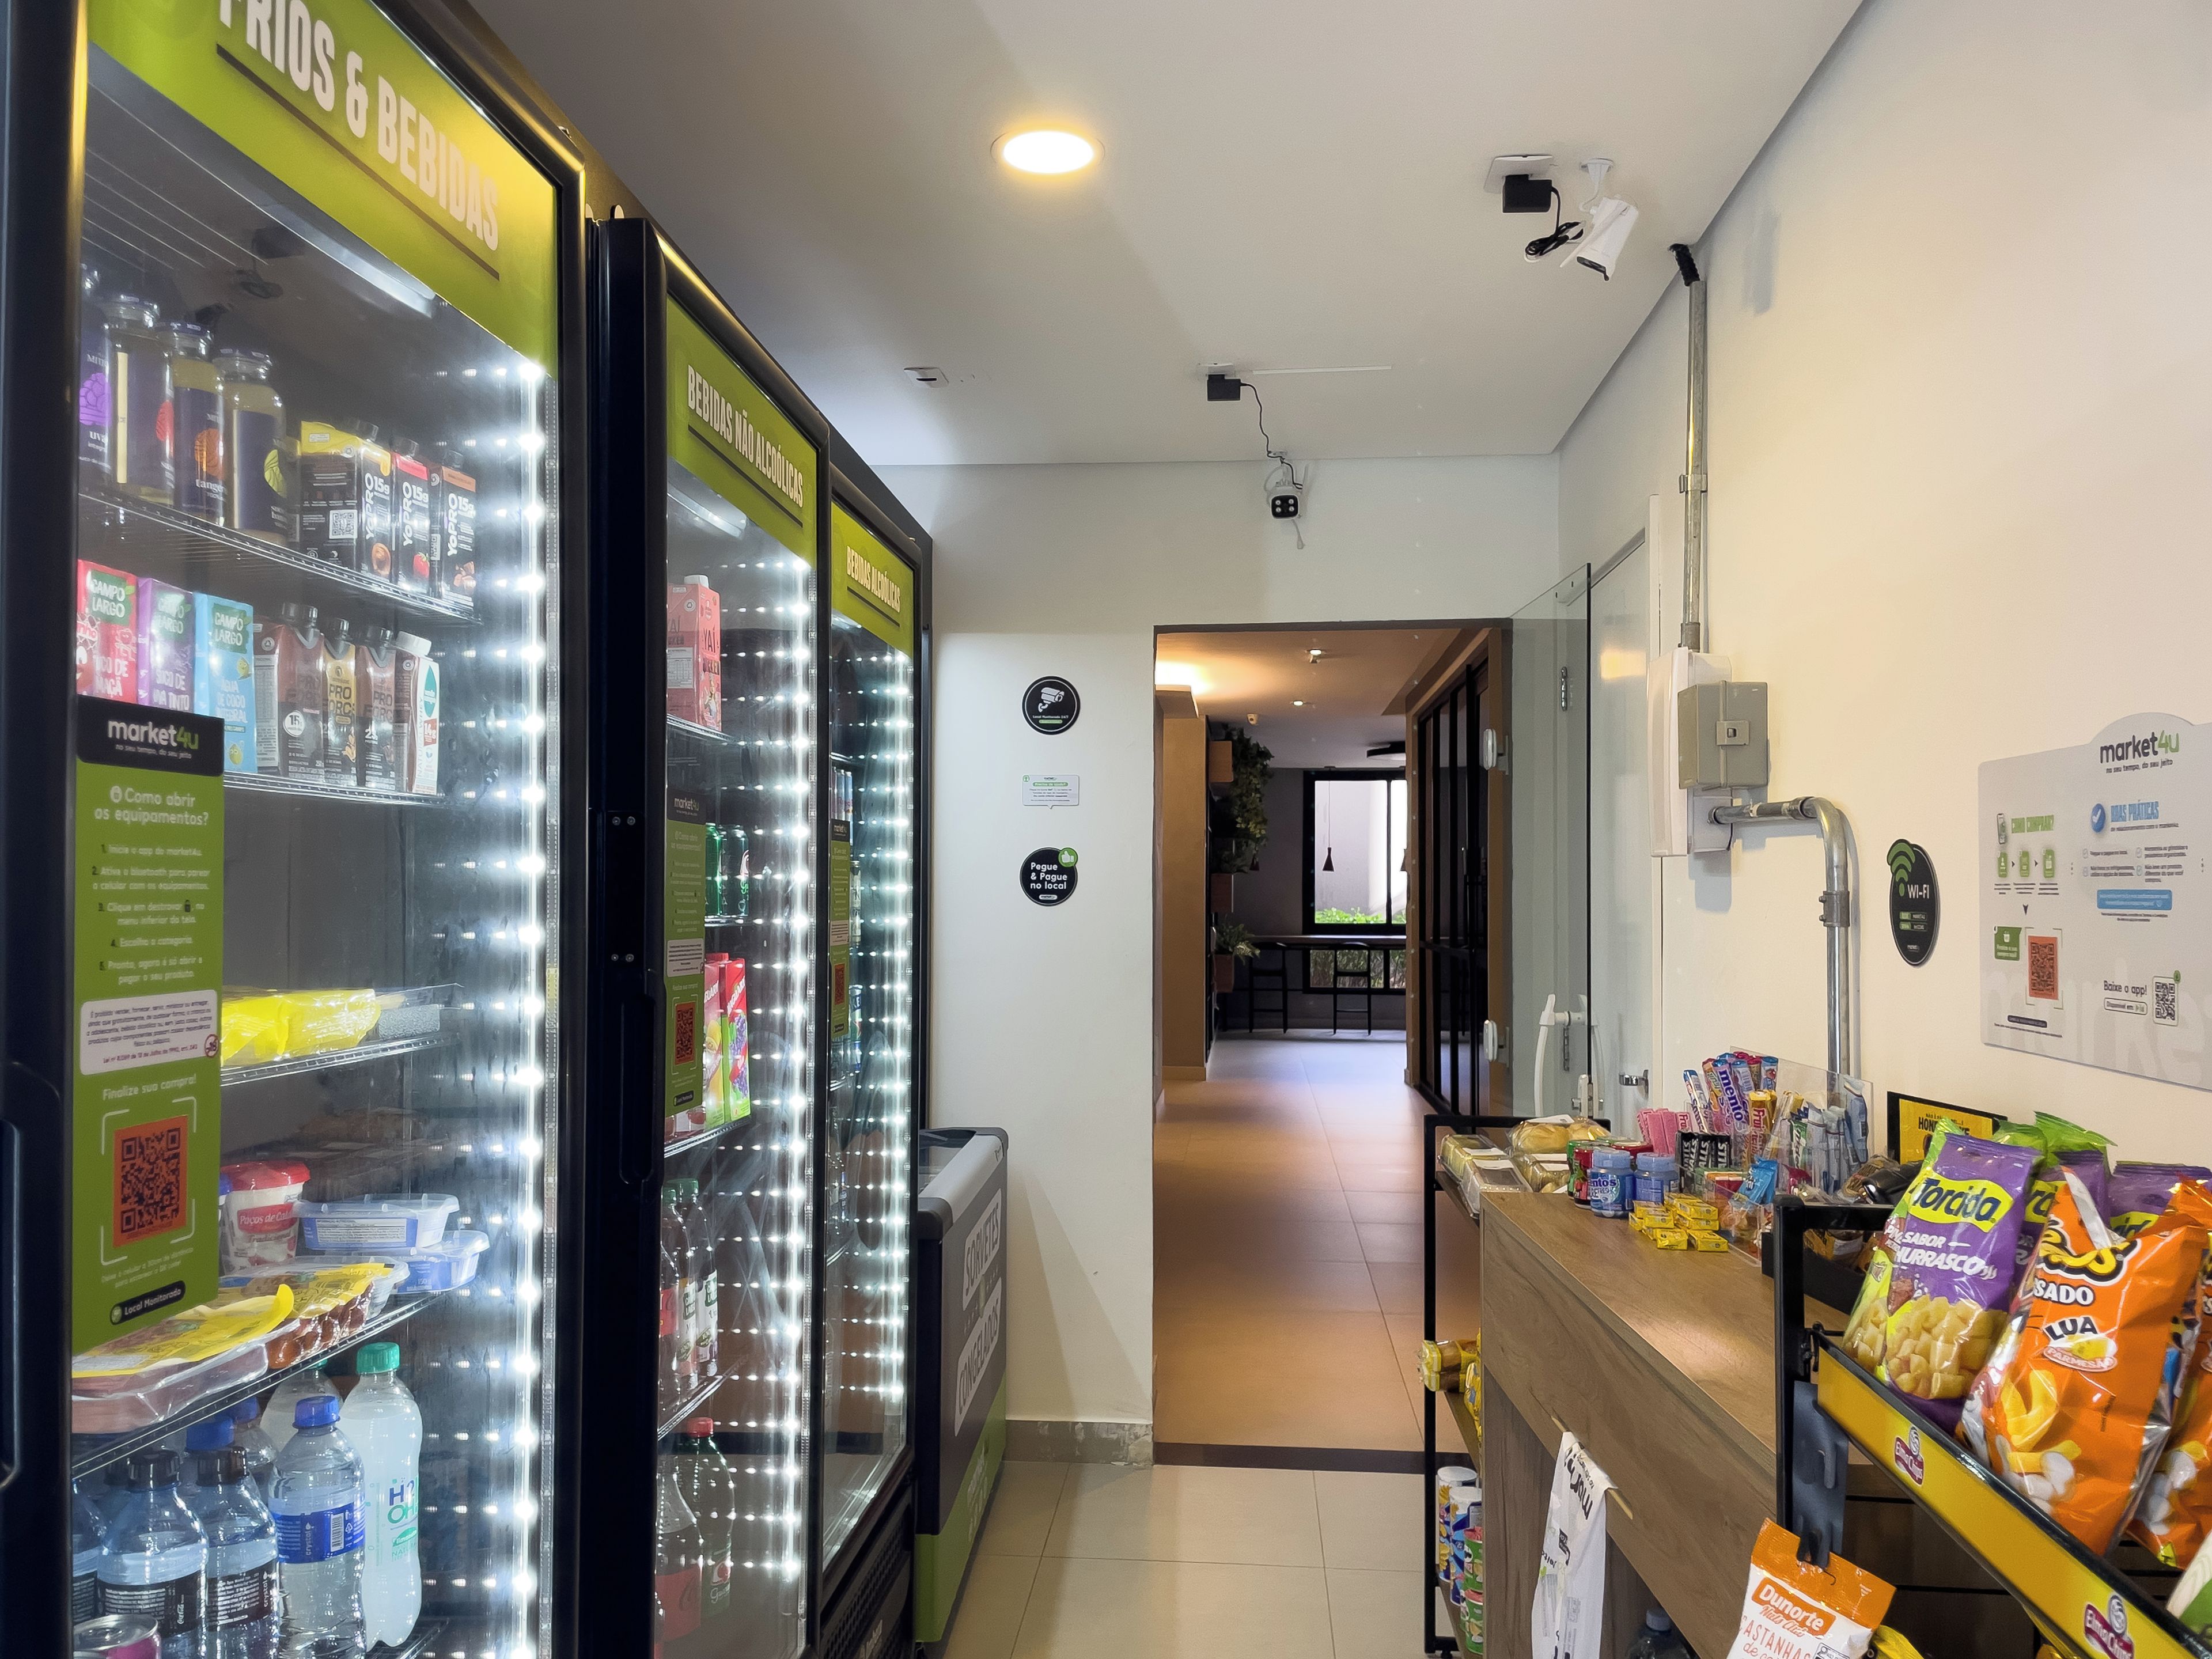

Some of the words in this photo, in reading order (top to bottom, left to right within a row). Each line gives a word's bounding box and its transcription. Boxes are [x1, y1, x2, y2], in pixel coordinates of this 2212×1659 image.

[346, 50, 369, 138] &
[378, 75, 498, 251] BEBIDAS
[688, 364, 733, 444] BEBIDAS
[734, 409, 755, 463] NÃO
[756, 431, 804, 509] ALCOÓLICAS
[90, 579, 126, 601] CAMPO
[847, 546, 871, 590] BEBIDAS
[871, 566, 901, 613] ALCOÓLICAS
[92, 597, 126, 618] LARGO
[214, 612, 244, 631] CAMPO
[215, 628, 244, 646] LARGO
[108, 720, 199, 750] market4u
[2100, 730, 2180, 764] market4u
[125, 787, 162, 805] Como
[166, 792, 196, 808] abrir
[94, 808, 111, 821] os
[115, 808, 210, 826] equipamentos?
[1030, 862, 1058, 872] Pegue
[1030, 872, 1037, 880] &
[1039, 872, 1068, 882] Pague
[1044, 881, 1067, 889] local
[2103, 980, 2122, 993] Baixe
[2124, 985, 2130, 994] o
[2131, 984, 2147, 998] app!
[102, 1086, 139, 1101] Finalize
[1914, 1177, 2002, 1223] Torcida
[240, 1213, 264, 1225] Poços
[265, 1212, 276, 1223] de
[965, 1202, 999, 1297] SORVETES
[1902, 1232, 1947, 1249] SABOR
[1895, 1247, 1987, 1275] HURRASCO
[124, 1301, 143, 1315] Local
[144, 1287, 182, 1308] Monitorado
[2033, 1277, 2095, 1306] SADO
[2044, 1317, 2099, 1341] LUA
[959, 1296, 999, 1416] CONGELADOS
[1759, 1584, 1825, 1631] Dunorte
[1743, 1642, 1759, 1657] de
